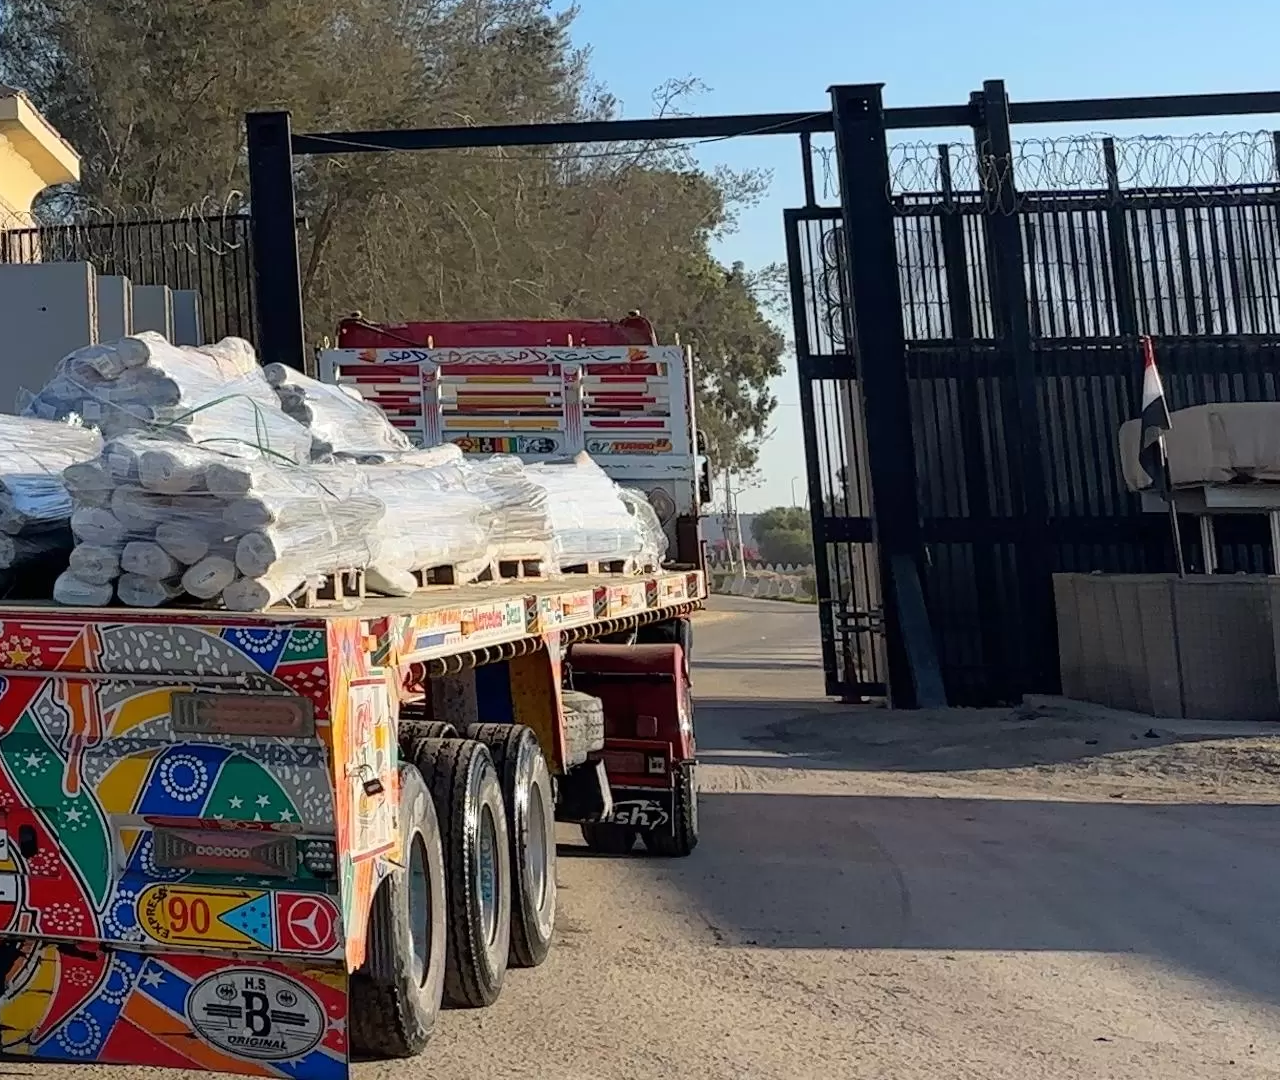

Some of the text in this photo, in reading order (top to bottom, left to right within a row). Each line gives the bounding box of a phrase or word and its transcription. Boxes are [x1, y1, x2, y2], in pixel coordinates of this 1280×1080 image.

[168, 896, 210, 934] 90
[244, 977, 267, 991] H.S
[241, 990, 272, 1037] B
[227, 1035, 288, 1050] ORIGINAL
